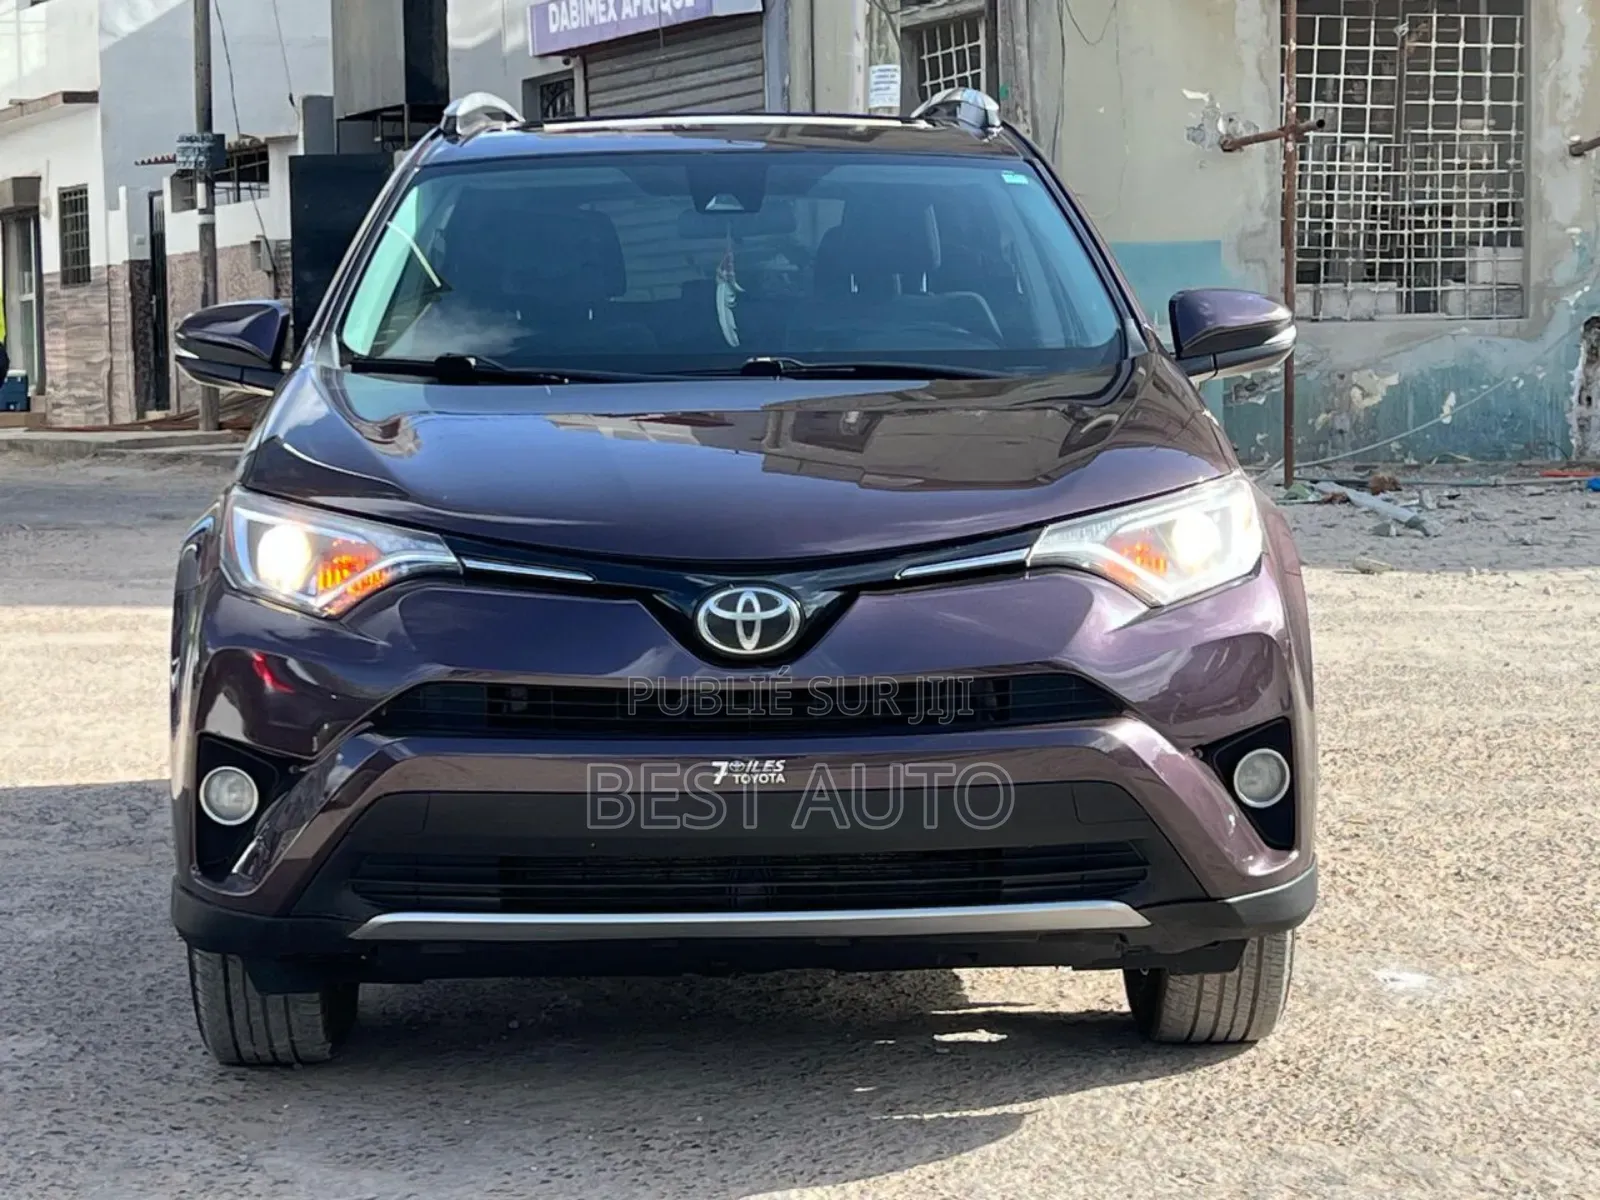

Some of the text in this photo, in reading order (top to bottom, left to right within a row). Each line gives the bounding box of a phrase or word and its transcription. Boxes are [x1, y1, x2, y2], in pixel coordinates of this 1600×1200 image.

[548, 0, 695, 33] DABIMEX AFRIQ
[712, 761, 728, 785] 7
[733, 773, 786, 785] TOYOTA
